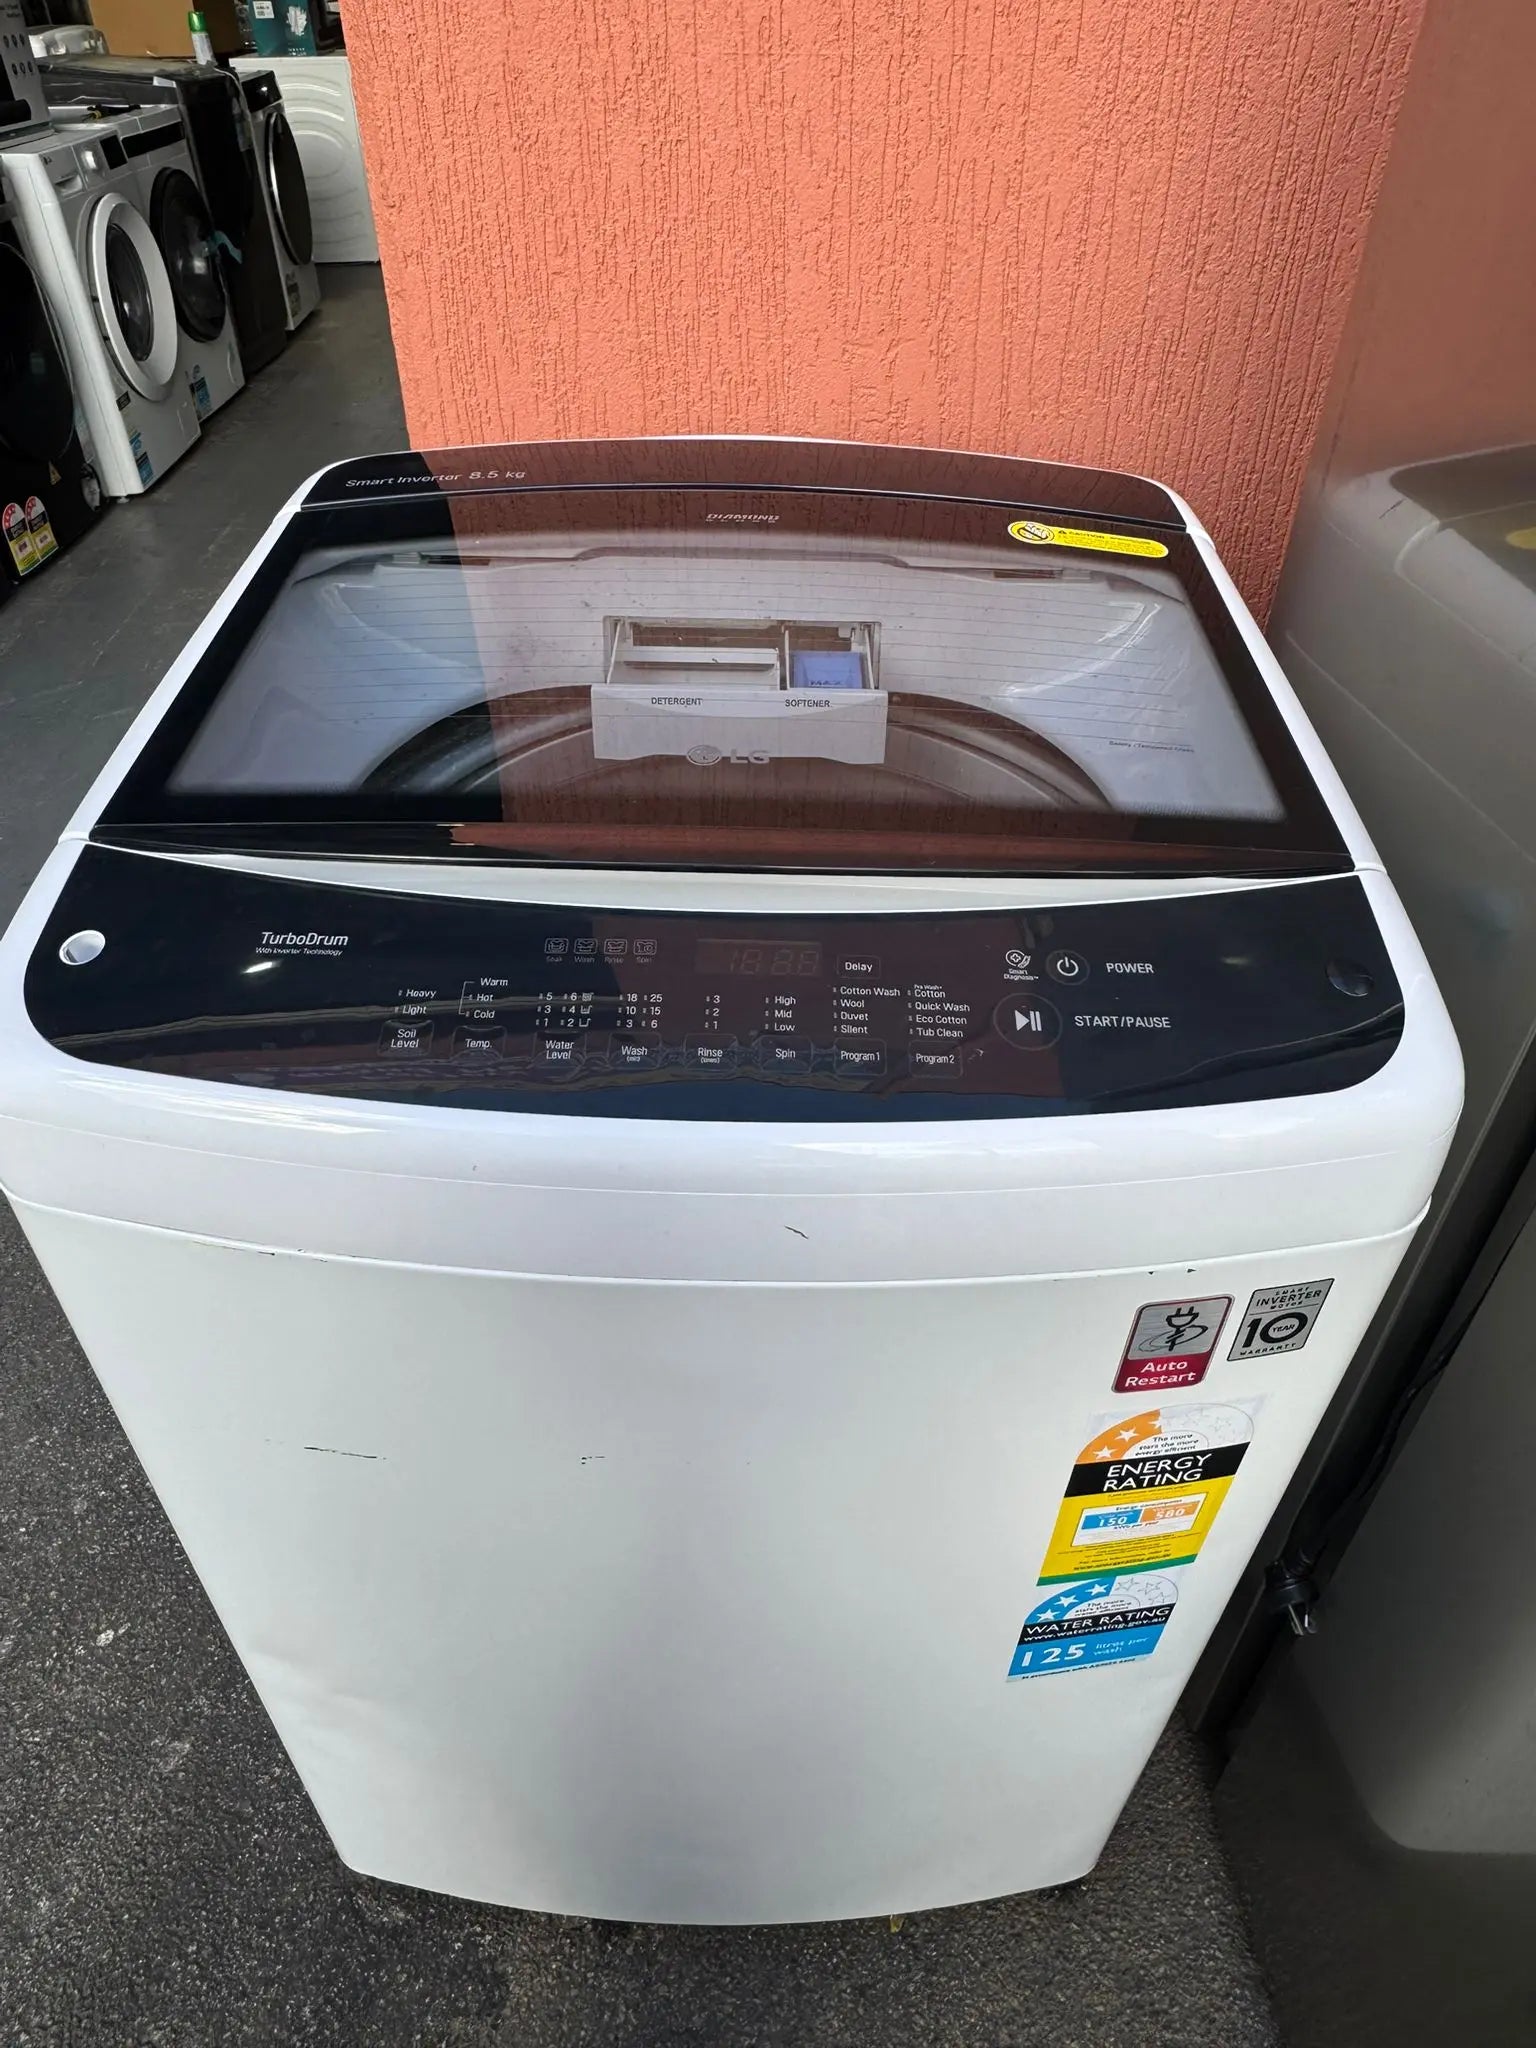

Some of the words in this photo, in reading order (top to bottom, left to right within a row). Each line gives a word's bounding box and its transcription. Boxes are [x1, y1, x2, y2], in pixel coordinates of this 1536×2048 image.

[345, 478, 394, 487] Smart
[398, 474, 462, 483] Inverter
[469, 470, 499, 480] 8.5
[505, 471, 526, 480] kg
[651, 697, 703, 706] DETERGENT
[785, 699, 830, 708] SOFTENER
[729, 749, 770, 764] LG
[262, 931, 349, 946] TurboDrum
[845, 961, 873, 973] Delay
[1106, 962, 1155, 974] POWER
[480, 977, 508, 987] Warm
[406, 989, 437, 999] Heavy
[546, 992, 553, 1001] 5
[570, 992, 578, 1001] 6
[840, 986, 872, 996] Cotton
[873, 988, 901, 997] Wash
[914, 989, 946, 999] Cotton
[476, 993, 494, 1002] Hot
[627, 993, 638, 1002] 18
[650, 994, 663, 1003] 25
[713, 994, 721, 1004] 3
[774, 995, 797, 1006] High
[840, 999, 865, 1008] Wool
[914, 1001, 941, 1011] Quick
[942, 1003, 971, 1012] Wash
[402, 1005, 427, 1016] Light
[473, 1010, 495, 1019] Cold
[544, 1005, 552, 1014] 3
[569, 1005, 576, 1014] 4
[626, 1006, 637, 1015] 10
[650, 1006, 661, 1016] 15
[712, 1007, 720, 1017] 2
[774, 1009, 793, 1018] Mid
[840, 1011, 869, 1021] Duvet
[915, 1014, 934, 1023] Eco
[935, 1015, 968, 1025] Cotton
[543, 1018, 549, 1027] 1
[567, 1018, 575, 1027] 2
[625, 1020, 633, 1028] 3
[650, 1020, 658, 1029] 6
[712, 1020, 719, 1030] 1
[774, 1022, 796, 1032] Low
[1074, 1015, 1172, 1029] START/PAUSE
[397, 1028, 417, 1038] Soil
[840, 1024, 869, 1034] Silent
[916, 1027, 936, 1037] Tub
[936, 1028, 964, 1038] Clean
[390, 1038, 420, 1049] Level
[465, 1038, 493, 1050] Temp.
[545, 1040, 575, 1050] Water
[546, 1049, 572, 1060] Level
[621, 1045, 648, 1056] Wash
[698, 1047, 723, 1058] Rinse
[775, 1048, 797, 1060] Spin
[840, 1050, 875, 1063] Program
[875, 1051, 881, 1062] 1
[915, 1053, 950, 1065] Program
[949, 1055, 956, 1064] 2
[1256, 1289, 1322, 1307] INVERTER
[1242, 1311, 1309, 1349] 10
[1272, 1323, 1296, 1333] YEAR
[1140, 1361, 1188, 1374] Auto
[1125, 1372, 1196, 1388] Restart
[1107, 1453, 1212, 1478] ENERGY
[1102, 1469, 1203, 1492] RATING
[1099, 1516, 1128, 1527] 150
[1026, 1620, 1093, 1635] WATER
[1100, 1606, 1171, 1627] RATING
[1021, 1643, 1087, 1667] 125
